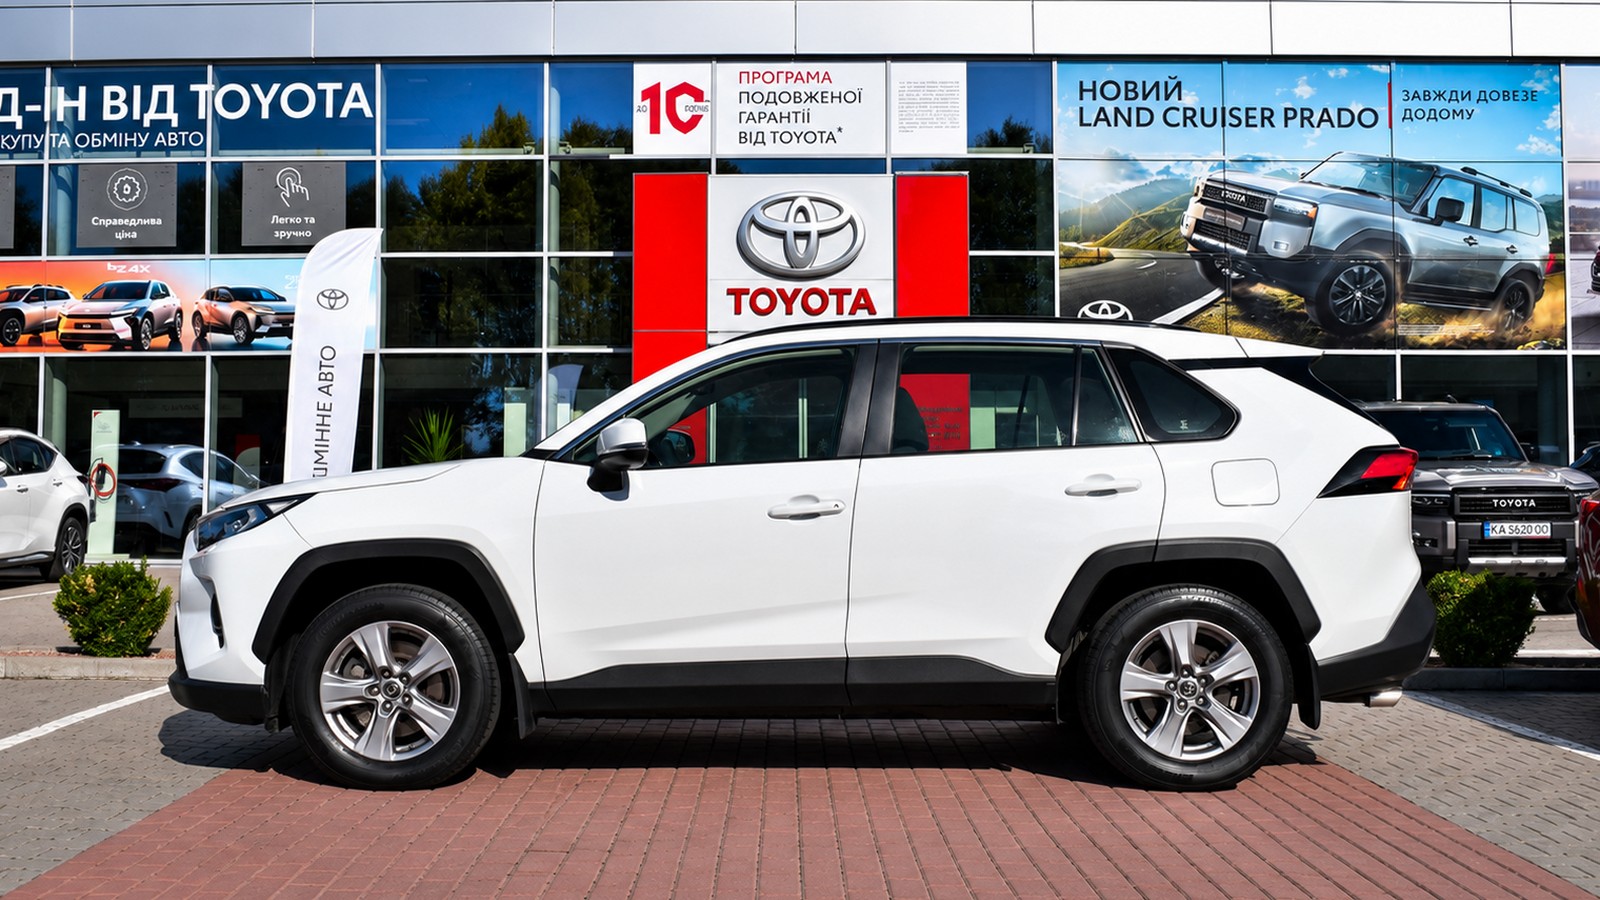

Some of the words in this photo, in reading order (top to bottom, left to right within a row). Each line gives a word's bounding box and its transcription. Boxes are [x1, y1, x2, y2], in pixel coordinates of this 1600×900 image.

[739, 71, 833, 85] ПРОГРАМА
[1078, 75, 1182, 101] НОВИЙ
[1401, 89, 1472, 103] ЗАВЖДИ
[1476, 89, 1539, 103] ДОВЕЗЕ
[102, 85, 179, 128] ВІД
[189, 82, 374, 120] TOYOTA
[738, 88, 863, 106] ПОДОВЖЕНОЇ
[1079, 106, 1155, 127] LAND
[1162, 106, 1275, 128] CRUISER
[1283, 107, 1379, 129] PRADO
[1401, 108, 1475, 122] ДОДОМУ
[50, 133, 70, 148] ТА
[75, 132, 150, 148] ОБМІНУ
[154, 131, 204, 147] АВТО
[738, 130, 767, 146] ВІД
[91, 216, 163, 228] Справедлива
[270, 215, 302, 225] Легко
[304, 216, 316, 225] та
[273, 229, 312, 240] зручно
[726, 287, 877, 316] TOYOTA
[317, 345, 336, 397] АВТО
[1492, 499, 1536, 508] TOYOTA
